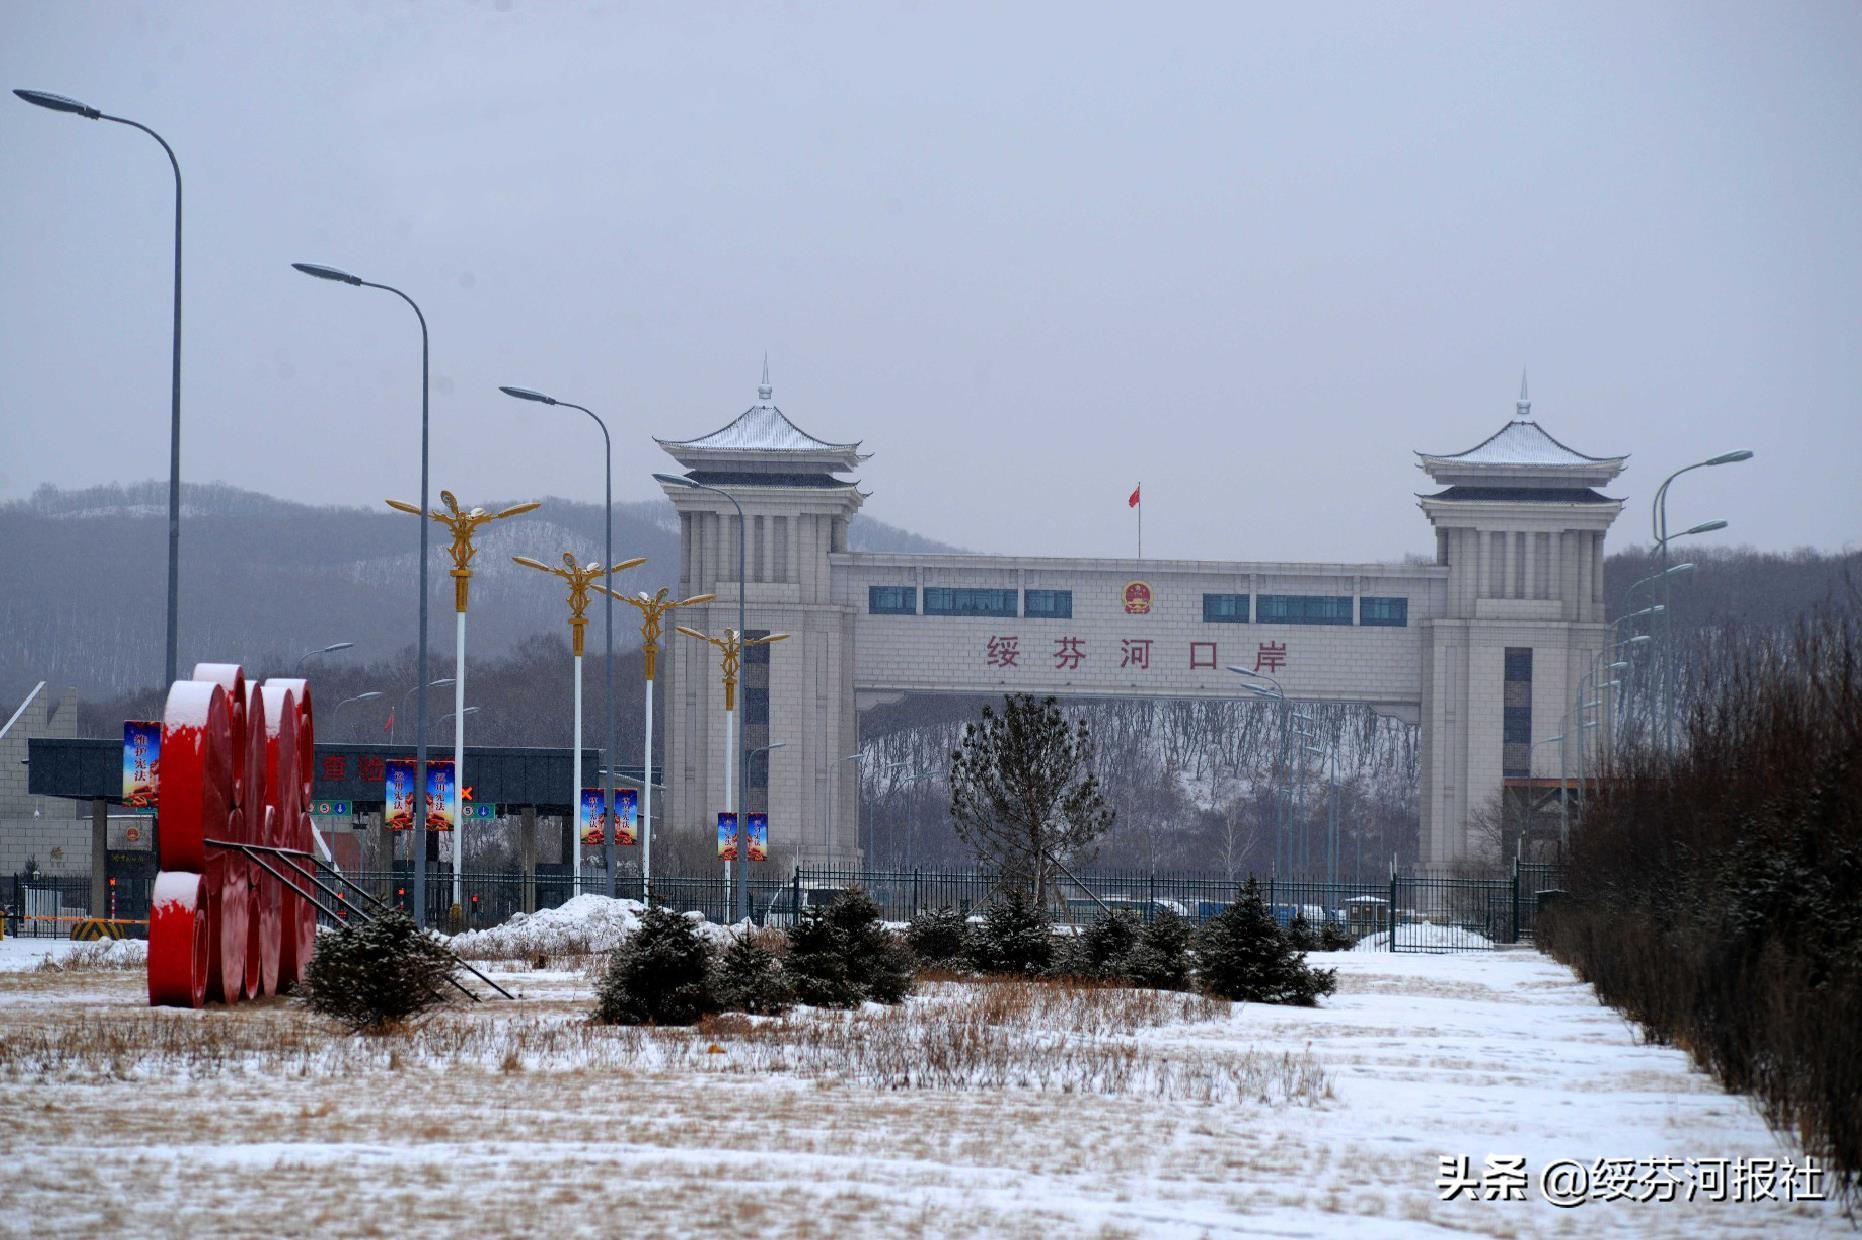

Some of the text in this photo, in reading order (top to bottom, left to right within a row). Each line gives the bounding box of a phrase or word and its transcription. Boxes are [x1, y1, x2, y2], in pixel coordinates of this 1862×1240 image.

[986, 635, 1288, 673] 绥芬河口岸
[134, 734, 148, 782] 维护宪法
